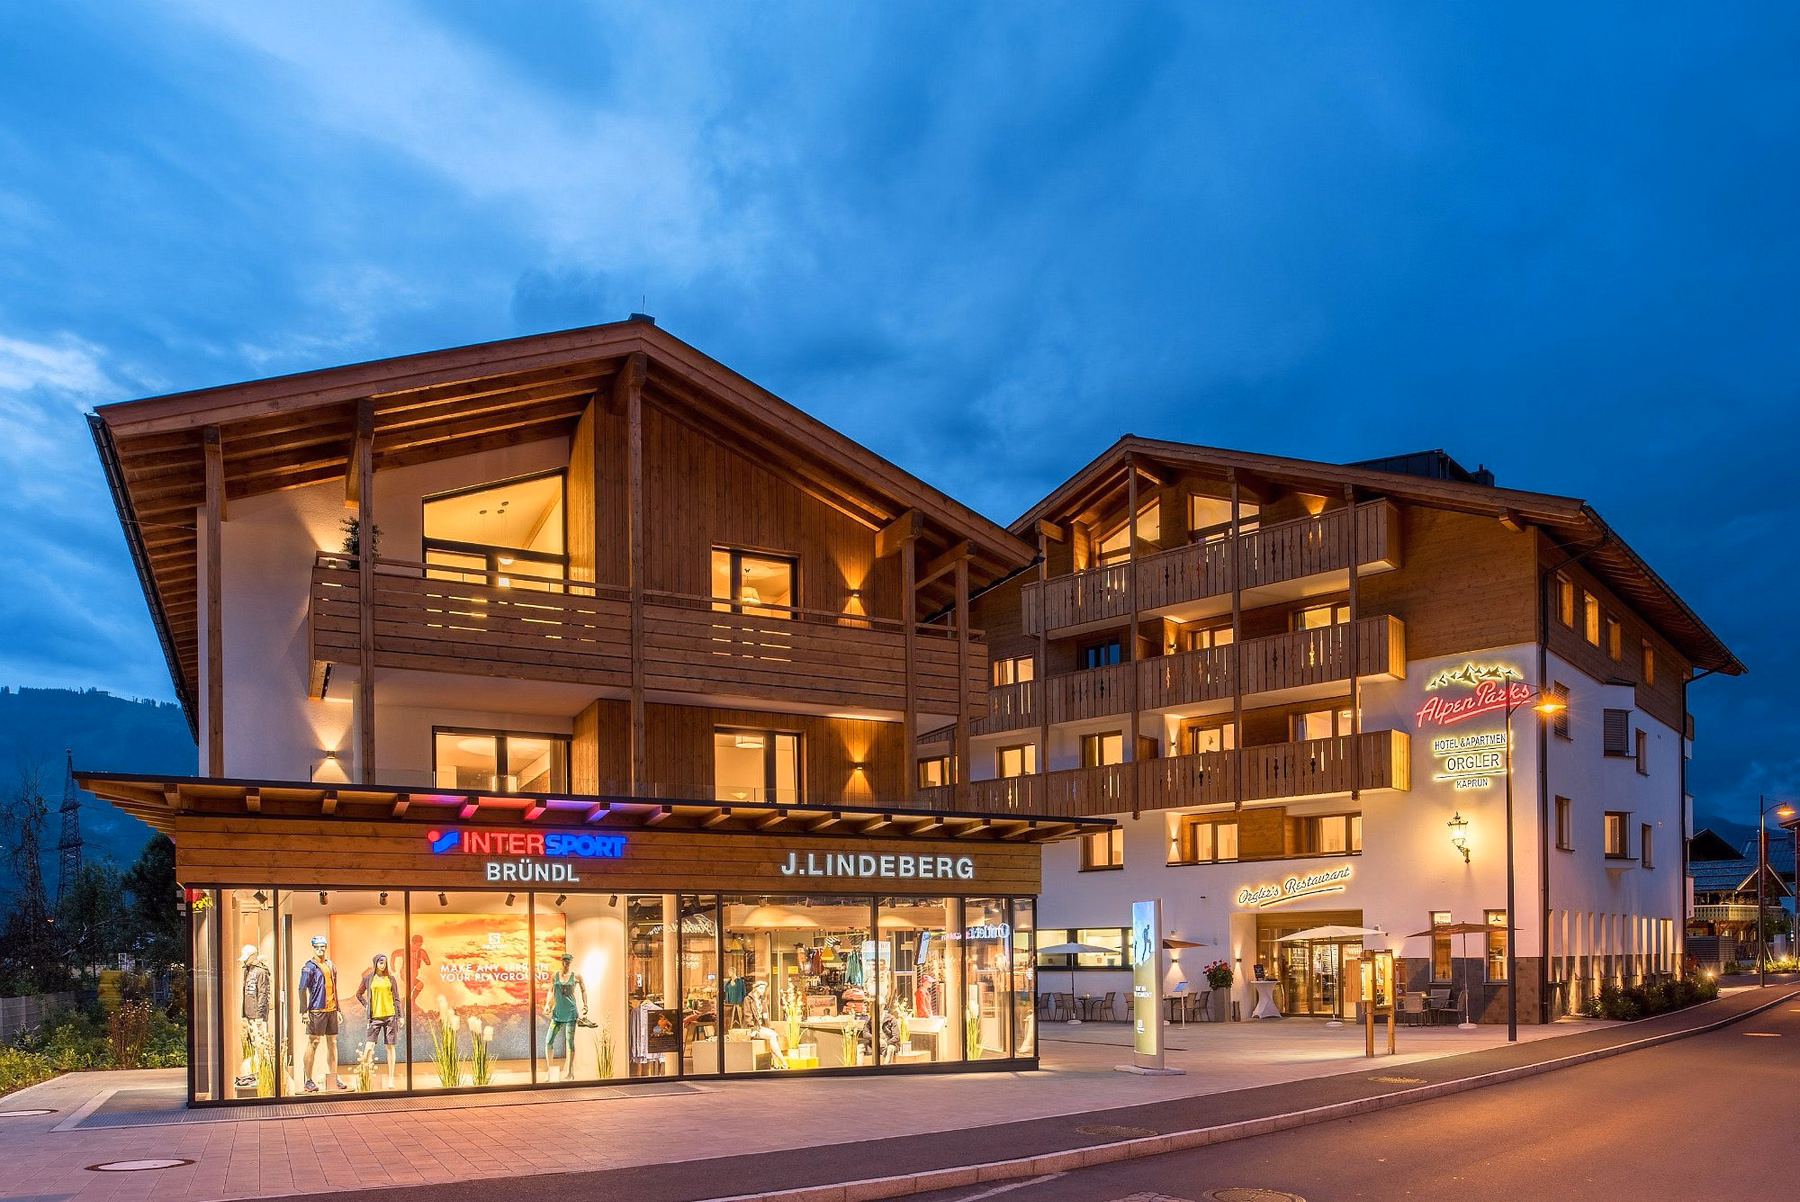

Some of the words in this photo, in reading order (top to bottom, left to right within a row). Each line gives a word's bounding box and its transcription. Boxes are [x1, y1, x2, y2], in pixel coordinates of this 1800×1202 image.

[1434, 739, 1459, 751] HOTEL
[1447, 753, 1500, 771] ORGLER
[1456, 778, 1488, 789] KAPRUN
[463, 831, 627, 857] INTERSPORT
[487, 858, 580, 882] BRÜNDL
[781, 852, 974, 879] J.LINDEBERG
[1238, 886, 1279, 904] Orgler's
[1284, 867, 1350, 894] Restaurant
[440, 963, 472, 973] MAKE
[476, 963, 499, 973] ANY
[440, 973, 471, 983] YOUR
